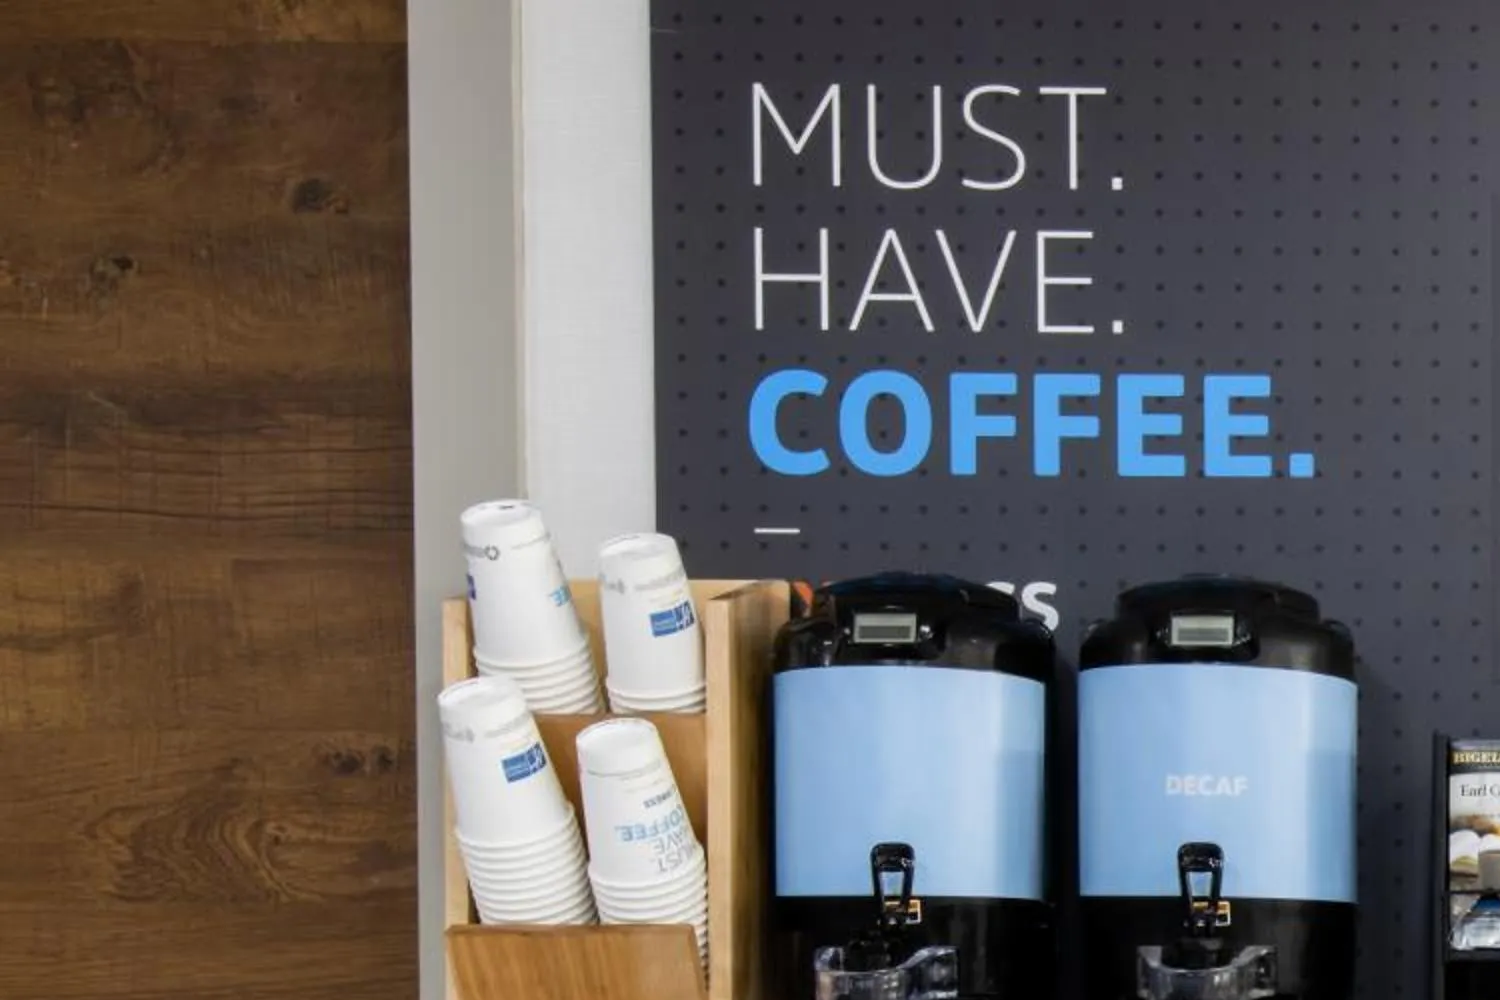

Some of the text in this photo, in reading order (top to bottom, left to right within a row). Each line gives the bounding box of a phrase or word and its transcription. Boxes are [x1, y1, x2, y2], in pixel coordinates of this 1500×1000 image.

[752, 82, 1124, 190] MUST.
[753, 227, 1124, 334] HAVE.
[748, 368, 1315, 478] COFFEE.
[1166, 775, 1248, 796] DECAF
[1460, 784, 1487, 797] Earl
